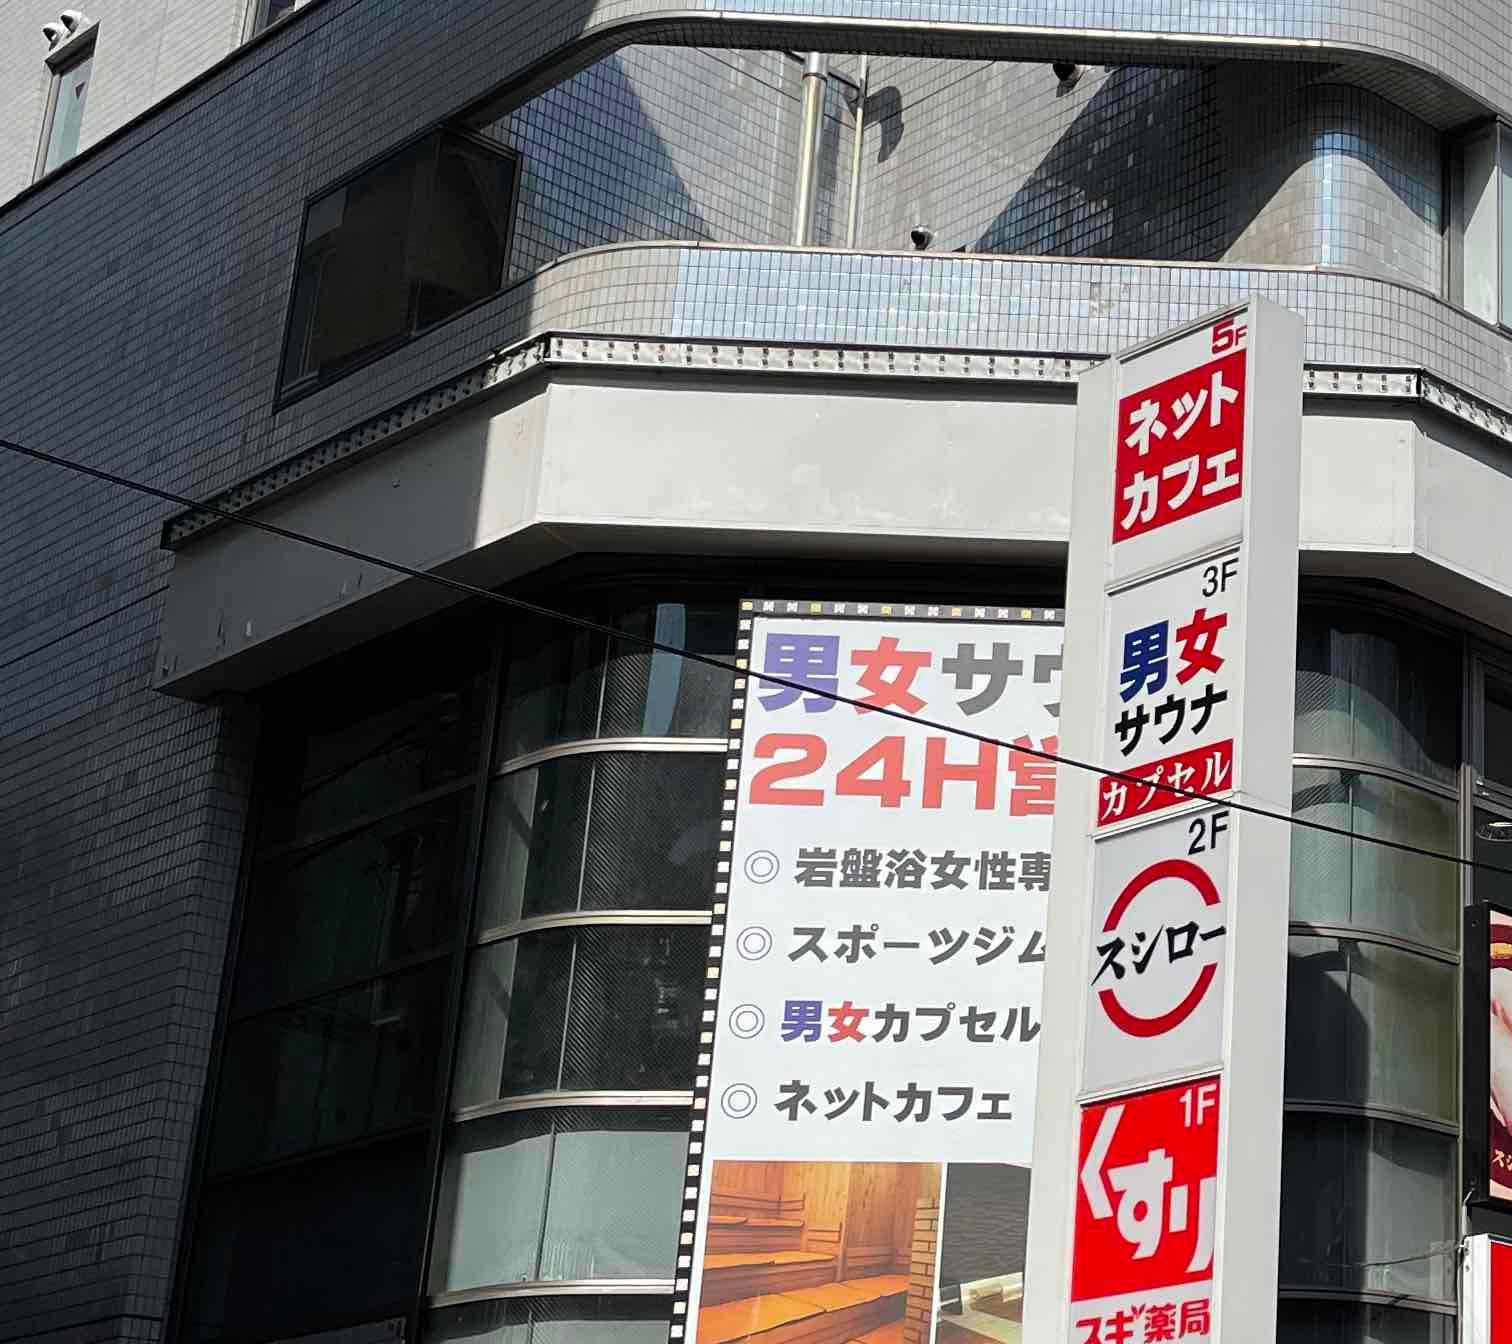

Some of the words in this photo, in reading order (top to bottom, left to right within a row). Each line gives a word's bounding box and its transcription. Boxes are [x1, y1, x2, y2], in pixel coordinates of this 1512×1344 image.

[1211, 319, 1248, 355] 5F
[1125, 370, 1239, 457] ネット
[1120, 448, 1240, 532] カフェ
[1202, 556, 1239, 597] 3F
[1119, 608, 1228, 703] 男女
[1114, 684, 1229, 756] サウナ
[1101, 750, 1232, 823] カプセル
[1187, 809, 1231, 856] 2F
[1091, 920, 1227, 986] スシロー
[780, 999, 1041, 1044] 男女カプセル
[774, 1079, 1013, 1123] ネットカフェ
[1178, 1081, 1218, 1130] 1F
[1080, 1102, 1216, 1275] くすり
